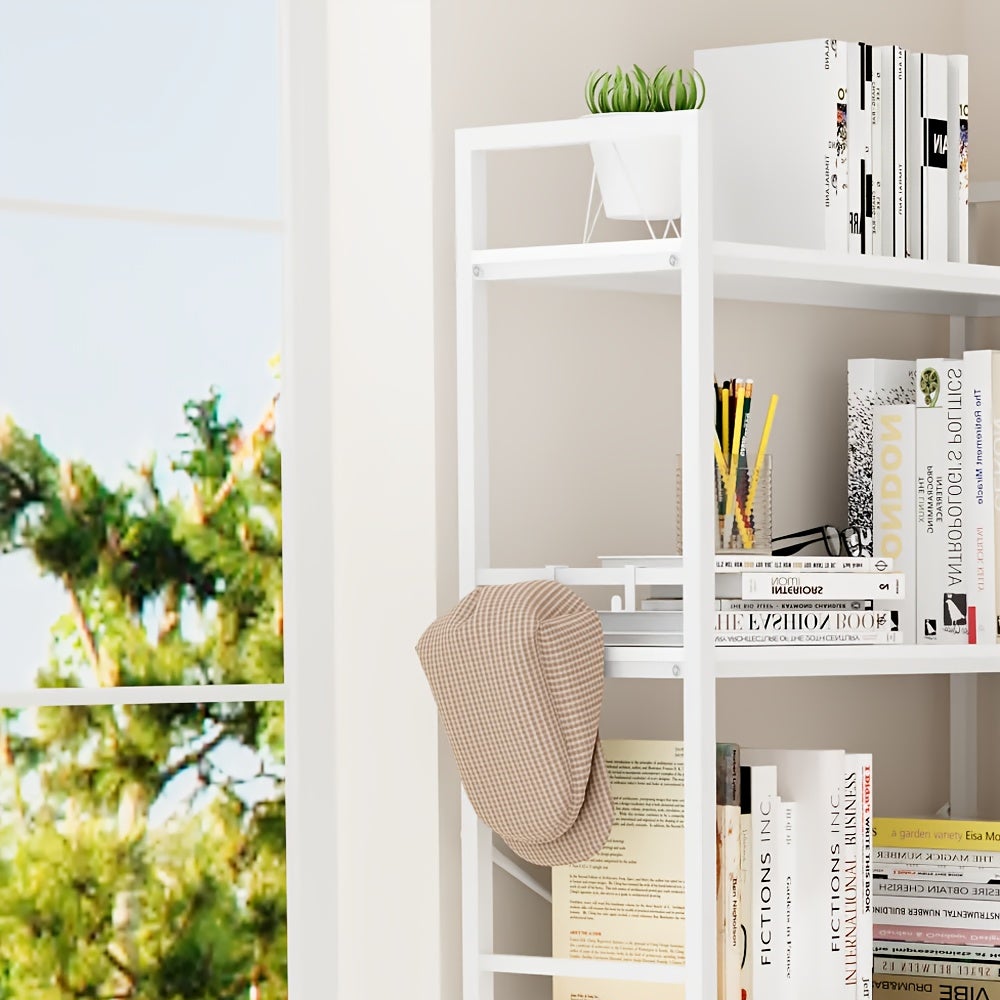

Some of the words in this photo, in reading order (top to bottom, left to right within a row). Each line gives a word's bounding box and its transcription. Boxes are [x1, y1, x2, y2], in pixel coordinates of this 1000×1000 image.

[845, 772, 857, 846] BUSINESS
[899, 828, 931, 840] garden
[934, 830, 963, 842] variety
[965, 830, 983, 842] Eisa
[760, 852, 772, 966] FICTIONS
[831, 843, 841, 952] FICTIONS
[845, 861, 857, 986] INTERNATIONAL
[873, 907, 906, 916] BUILDIN
[907, 908, 941, 917] NUMBER
